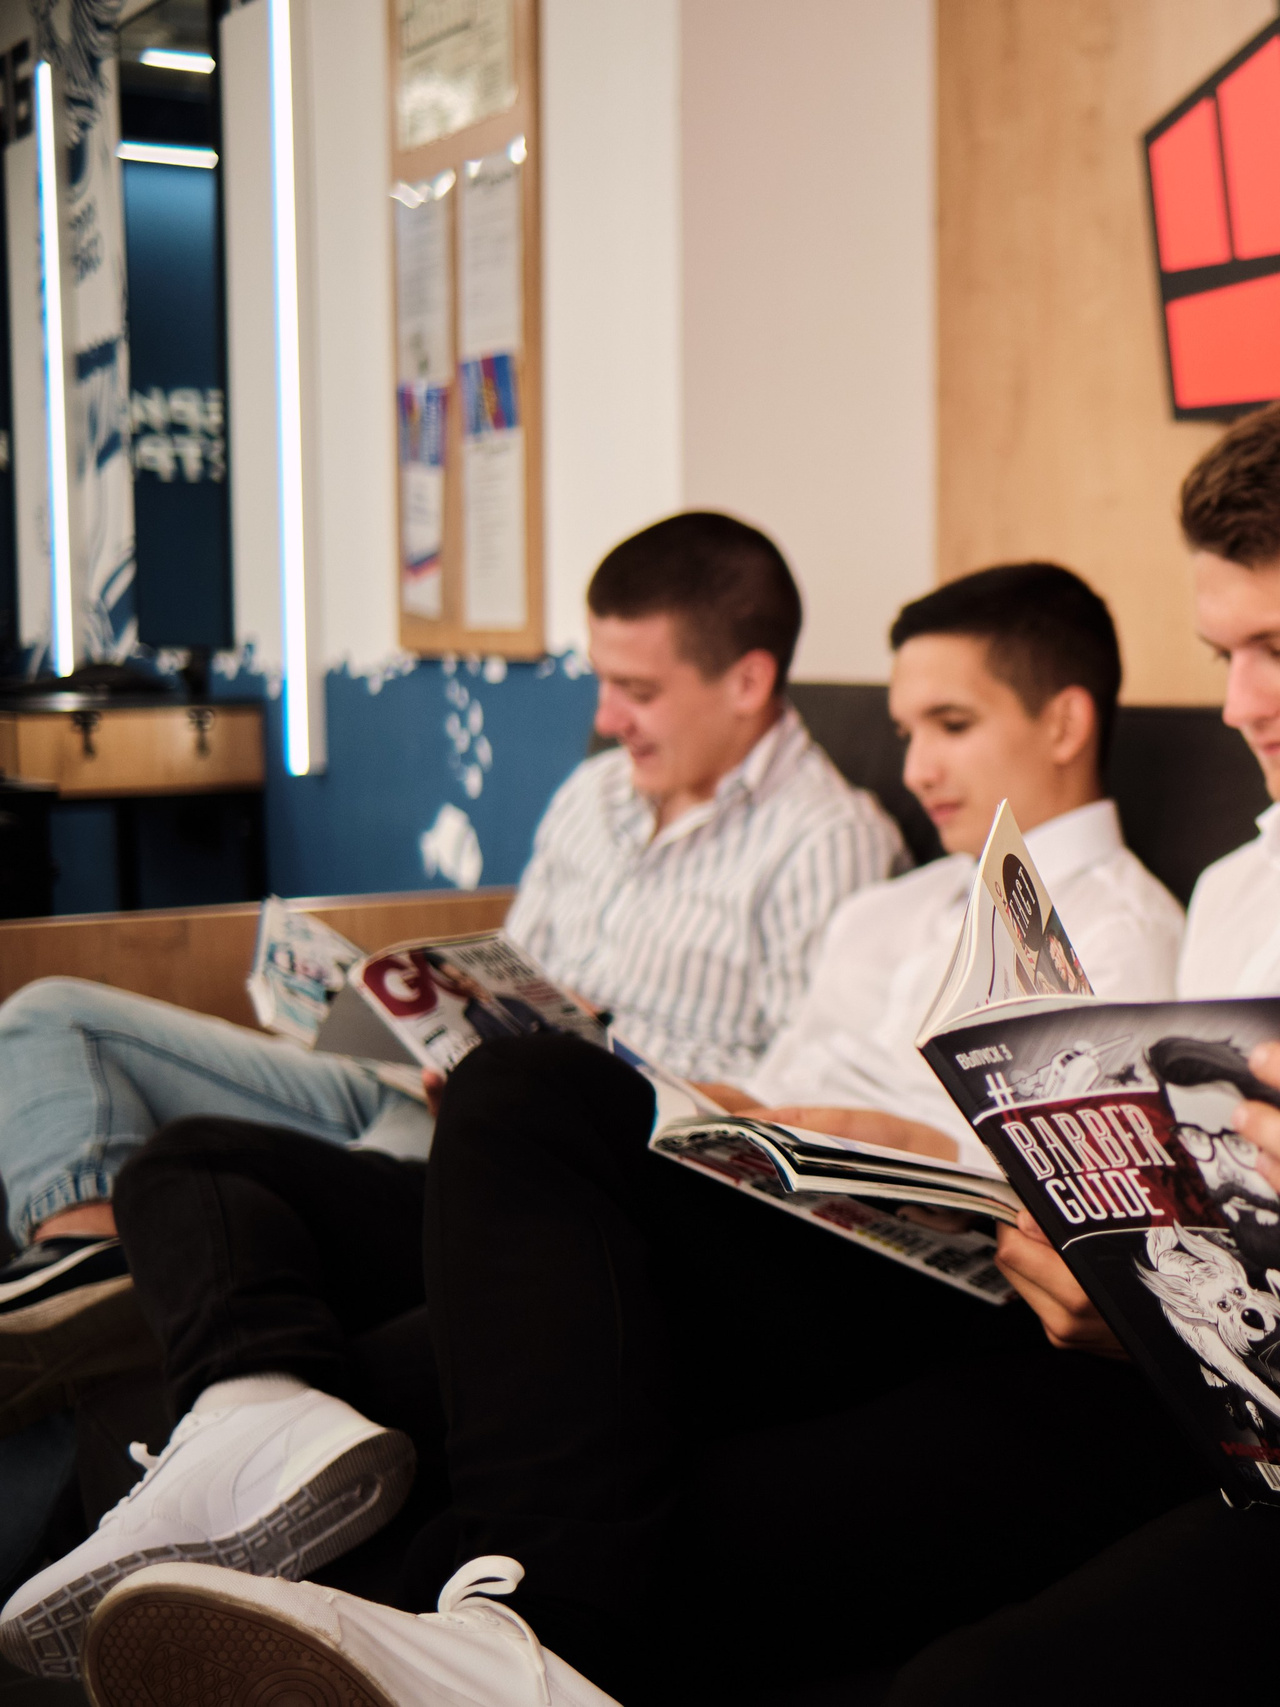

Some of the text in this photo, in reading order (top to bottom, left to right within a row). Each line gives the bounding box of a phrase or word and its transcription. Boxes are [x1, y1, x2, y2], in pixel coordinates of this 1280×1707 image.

[999, 1044, 1013, 1061] 3
[1001, 1104, 1176, 1181] BARBER
[1045, 1168, 1165, 1224] GUIDE
